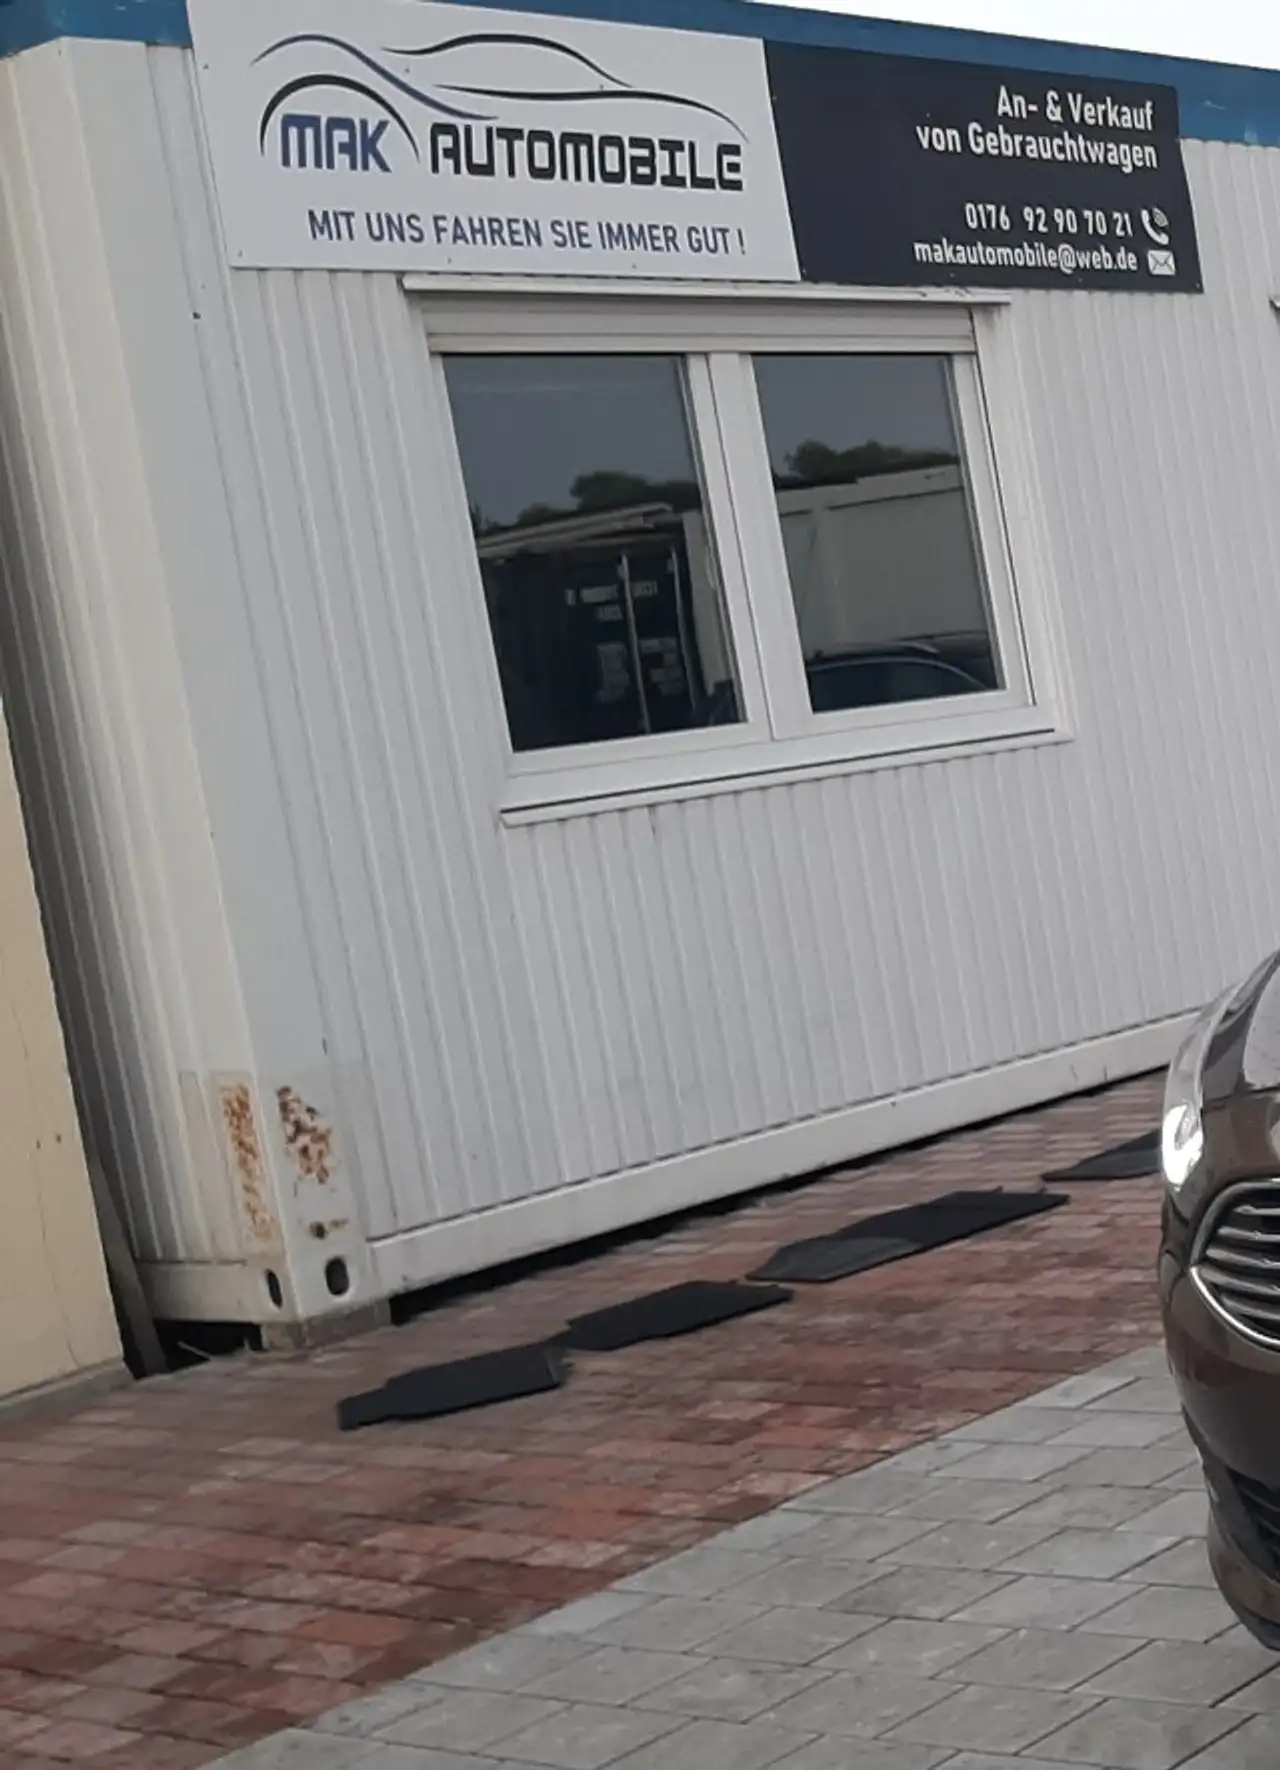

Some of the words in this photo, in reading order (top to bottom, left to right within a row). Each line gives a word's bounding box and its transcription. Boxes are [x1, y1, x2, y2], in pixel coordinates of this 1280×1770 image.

[998, 86, 1038, 119] An-
[1046, 90, 1063, 122] &
[1067, 92, 1154, 130] Verkauf
[281, 114, 392, 173] MAK
[430, 122, 744, 192] AUTOMOBILE
[916, 125, 961, 153] von
[967, 122, 1157, 174] Gebrauchtwagen
[308, 209, 355, 241] MIT
[365, 212, 424, 243] UNS
[433, 215, 543, 247] FAHREN
[550, 220, 592, 248] SIE
[597, 221, 681, 253] IMMER
[686, 226, 731, 254] GUT
[736, 228, 746, 255] !
[965, 203, 1010, 232] 0176
[1023, 206, 1048, 233] 92
[1054, 208, 1078, 234] 90
[1083, 210, 1107, 236] 70
[1112, 211, 1132, 237] 21
[913, 237, 1138, 274] makautomobile@web.de
